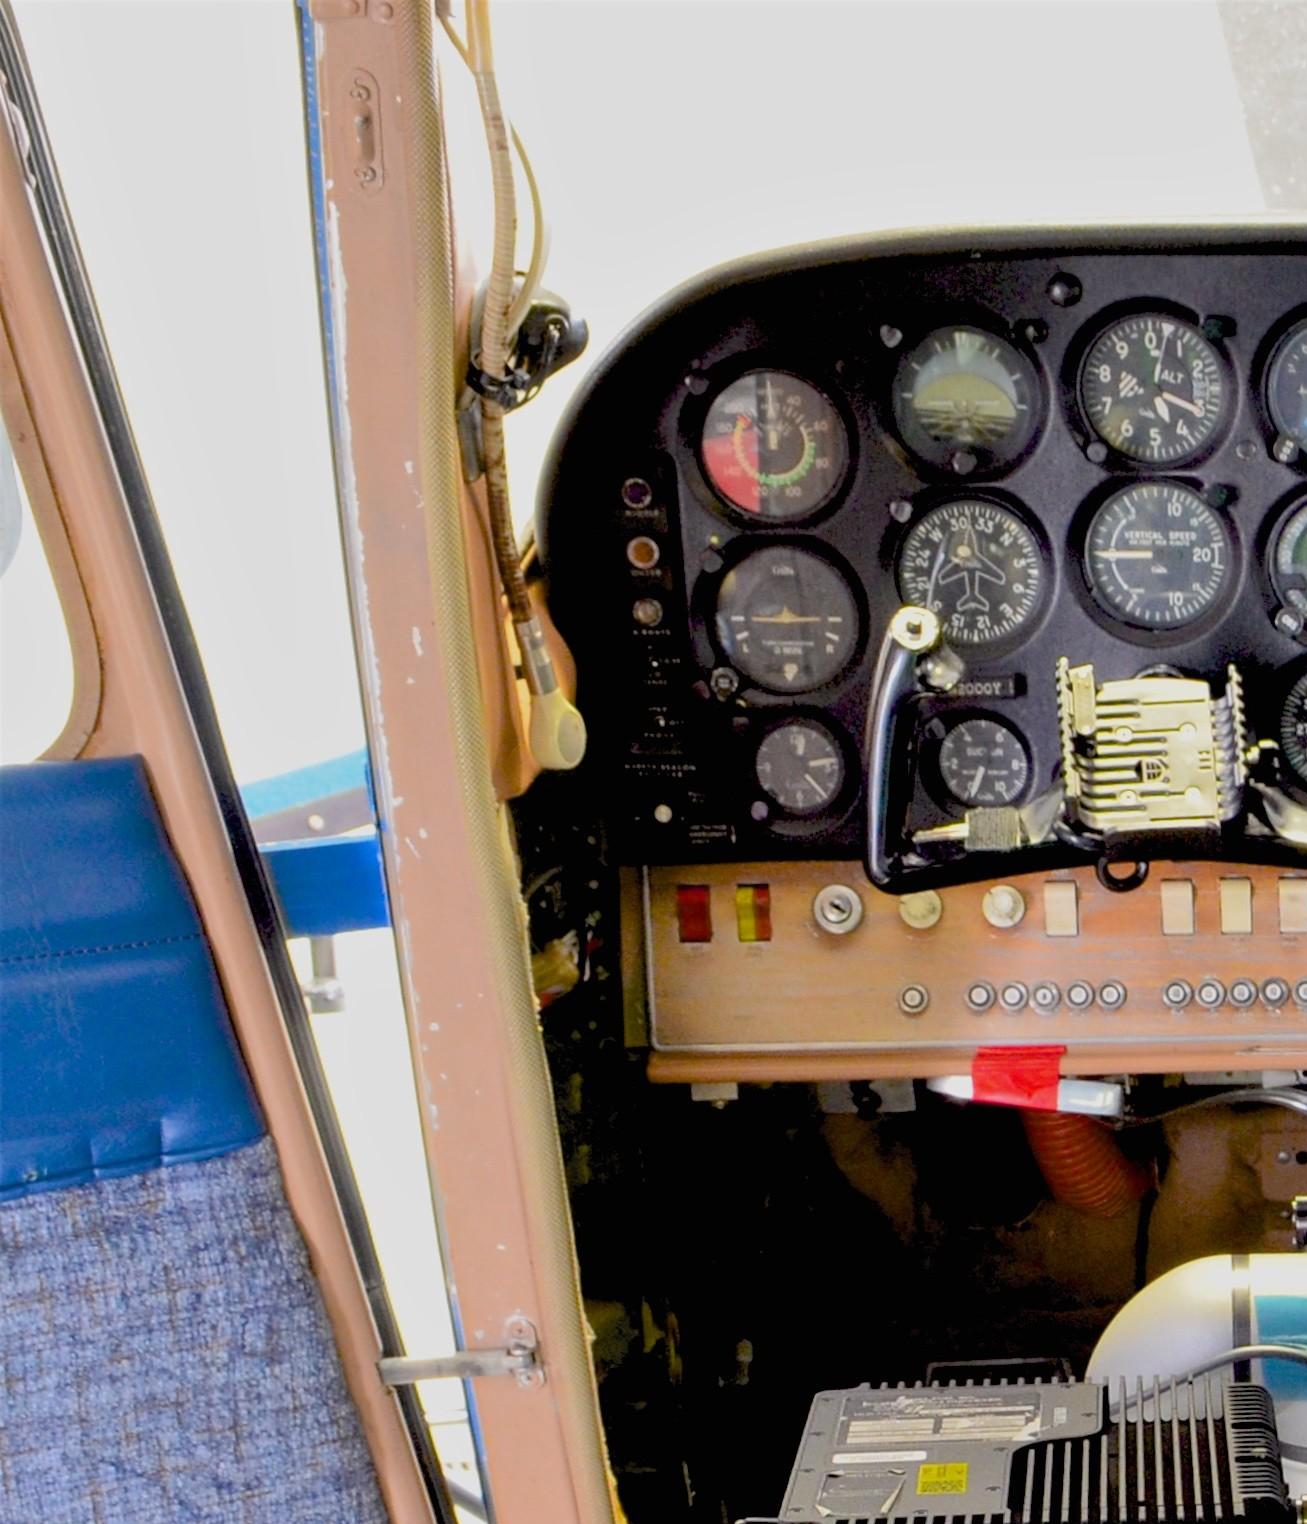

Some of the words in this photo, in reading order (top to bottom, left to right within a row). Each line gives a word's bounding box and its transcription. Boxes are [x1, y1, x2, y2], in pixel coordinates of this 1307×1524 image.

[1115, 341, 1129, 360] 9
[1099, 364, 1112, 383] 8
[1160, 369, 1184, 385] ALT
[1192, 360, 1204, 379] 2
[1101, 396, 1113, 415] 7
[1120, 418, 1134, 437] 6
[1176, 418, 1189, 437] 4
[1150, 427, 1162, 446] 5
[1167, 502, 1182, 517] 10
[950, 517, 968, 532] 30
[974, 517, 995, 534] 33
[928, 527, 944, 543] W
[1000, 532, 1014, 547] N
[1124, 530, 1164, 540] VERTICAL
[1168, 530, 1197, 541] SPEED
[916, 550, 931, 567] 24
[1192, 548, 1212, 563] 20
[917, 577, 930, 591] 21
[1168, 591, 1184, 606] 10
[1000, 603, 1014, 618] E
[951, 613, 965, 627] 15
[975, 615, 991, 629] 12
